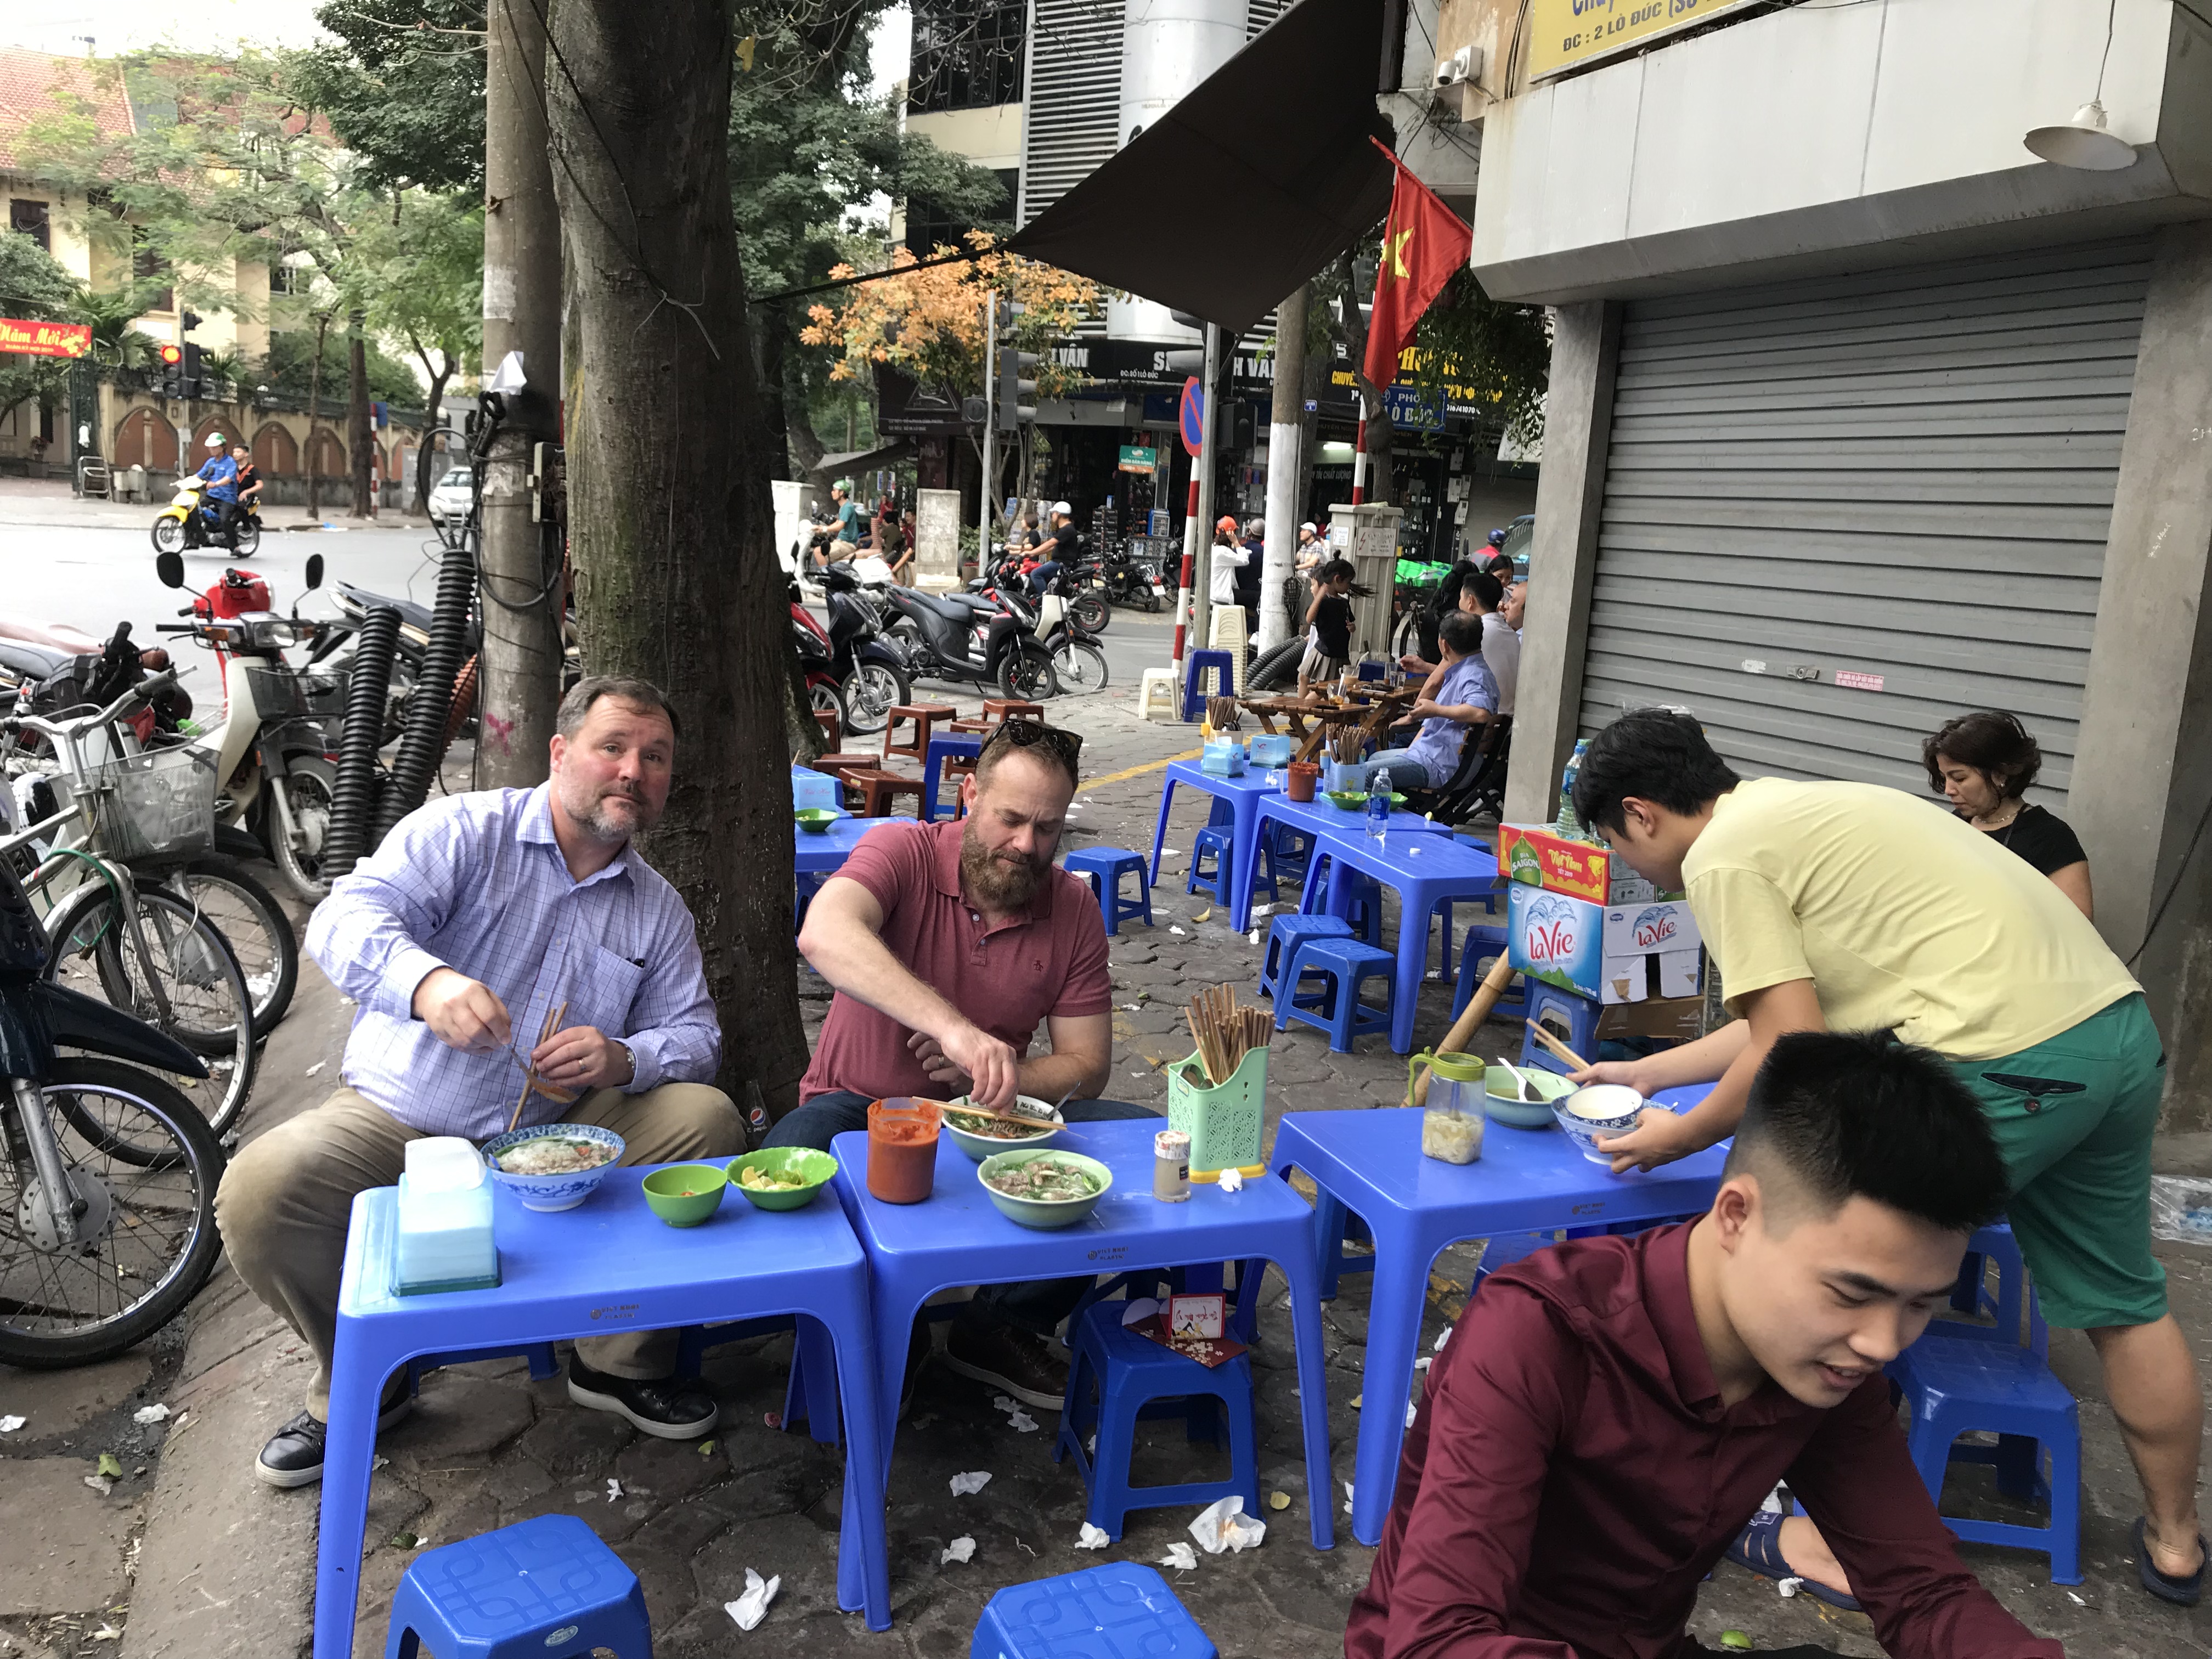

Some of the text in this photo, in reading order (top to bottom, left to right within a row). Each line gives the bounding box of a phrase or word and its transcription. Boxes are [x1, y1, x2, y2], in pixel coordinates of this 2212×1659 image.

[1563, 33, 1581, 52] ĐC
[1594, 25, 1603, 41] 2
[1607, 13, 1626, 35] LÒ
[1630, 1, 1662, 26] ĐÚC
[1512, 859, 1541, 872] SAIGON
